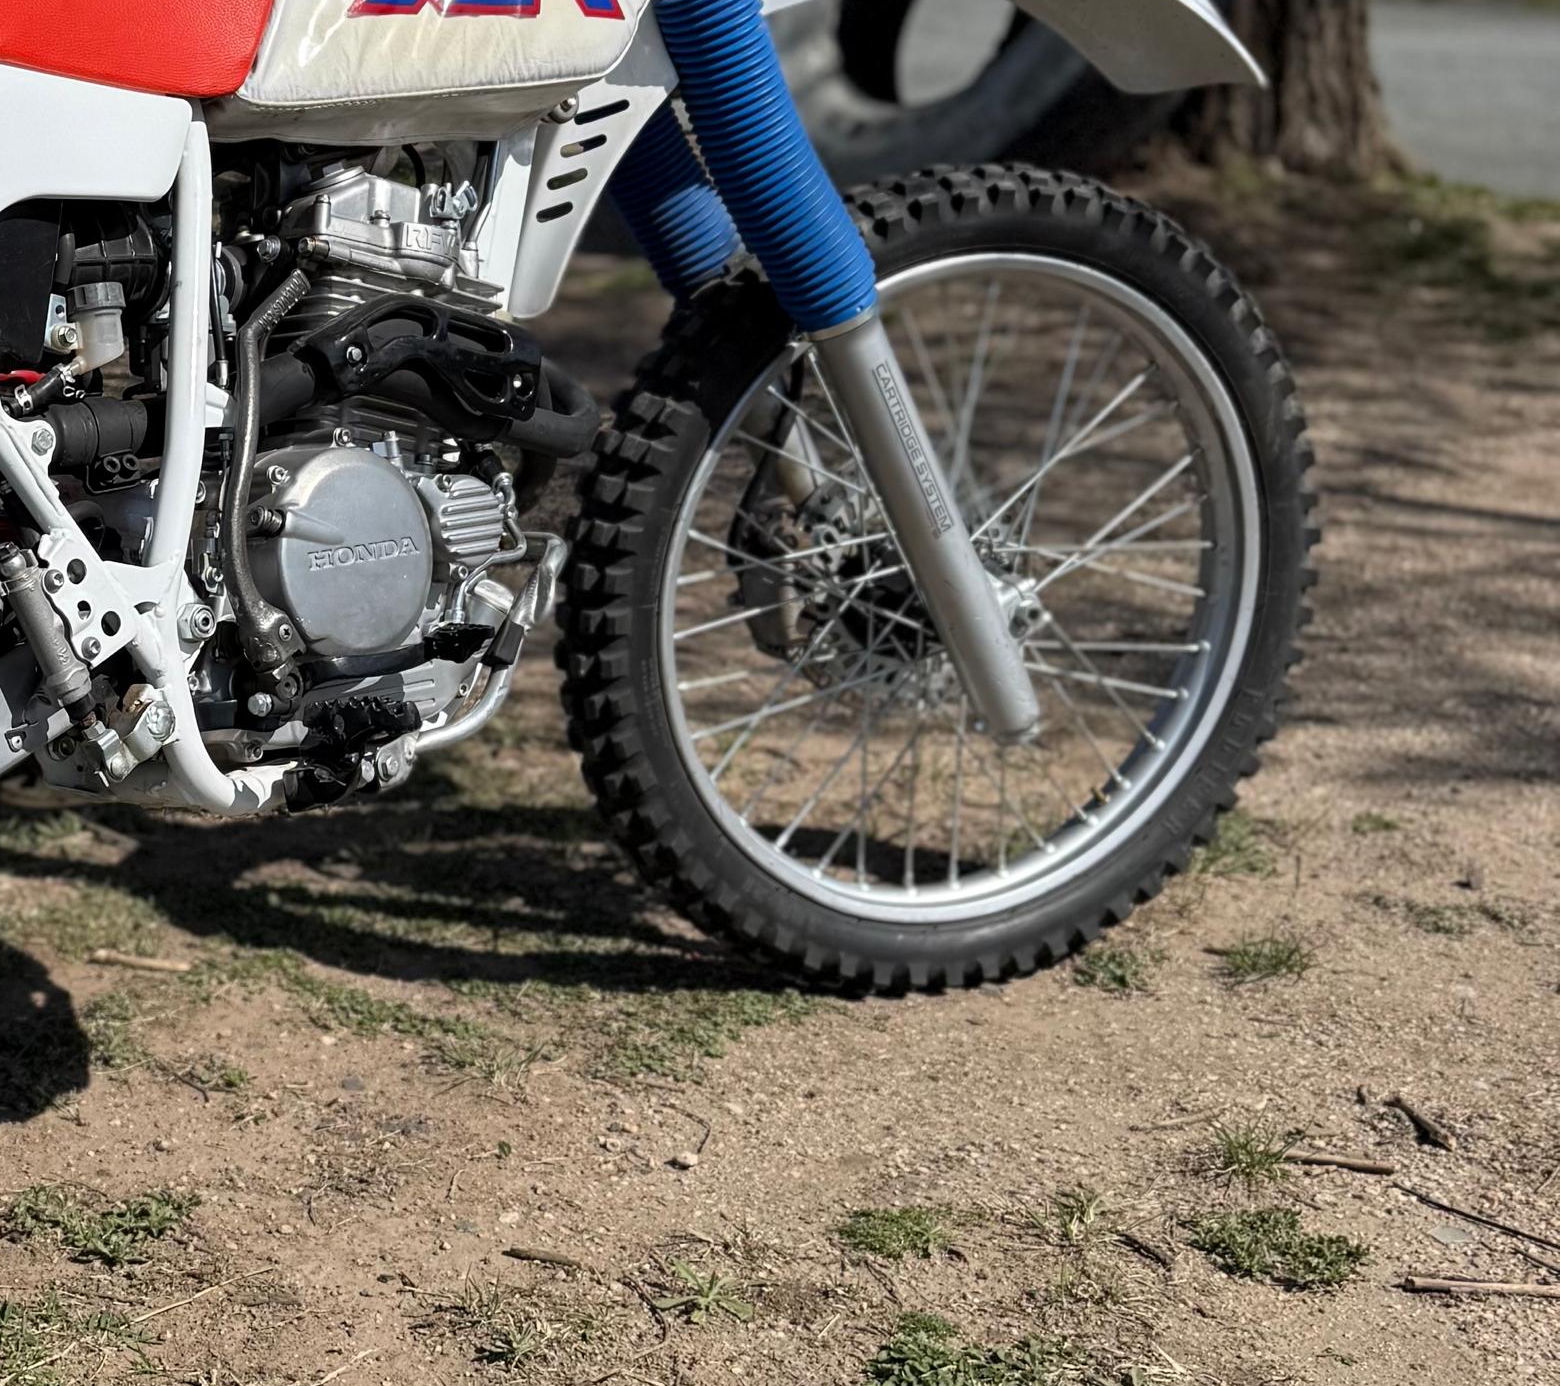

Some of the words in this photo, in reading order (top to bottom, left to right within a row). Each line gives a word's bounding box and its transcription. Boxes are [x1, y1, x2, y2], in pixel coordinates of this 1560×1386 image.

[875, 363, 922, 462] CARTRIDGE
[916, 462, 952, 533] SYSTEM
[307, 536, 421, 572] HONDA
